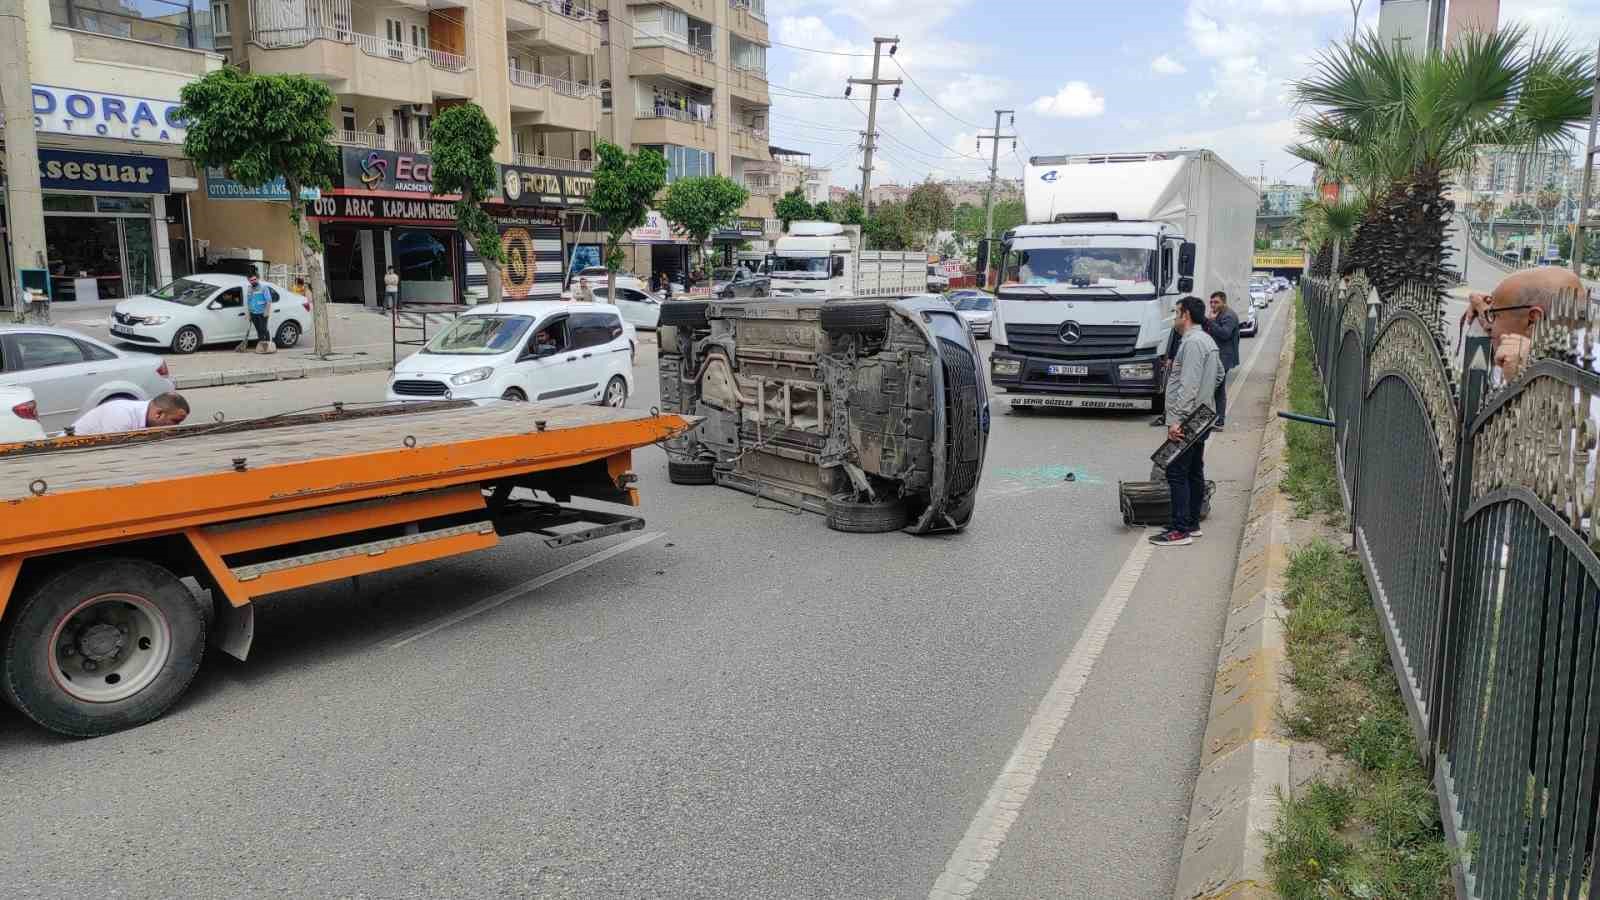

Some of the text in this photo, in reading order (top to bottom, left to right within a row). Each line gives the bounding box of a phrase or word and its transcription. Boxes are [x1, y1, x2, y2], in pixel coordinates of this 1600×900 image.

[40, 159, 153, 184] sesuar
[209, 183, 226, 195] OTO
[314, 199, 337, 216] OTO
[345, 199, 375, 217] ARAÇ
[382, 200, 427, 219] KAPLAMA
